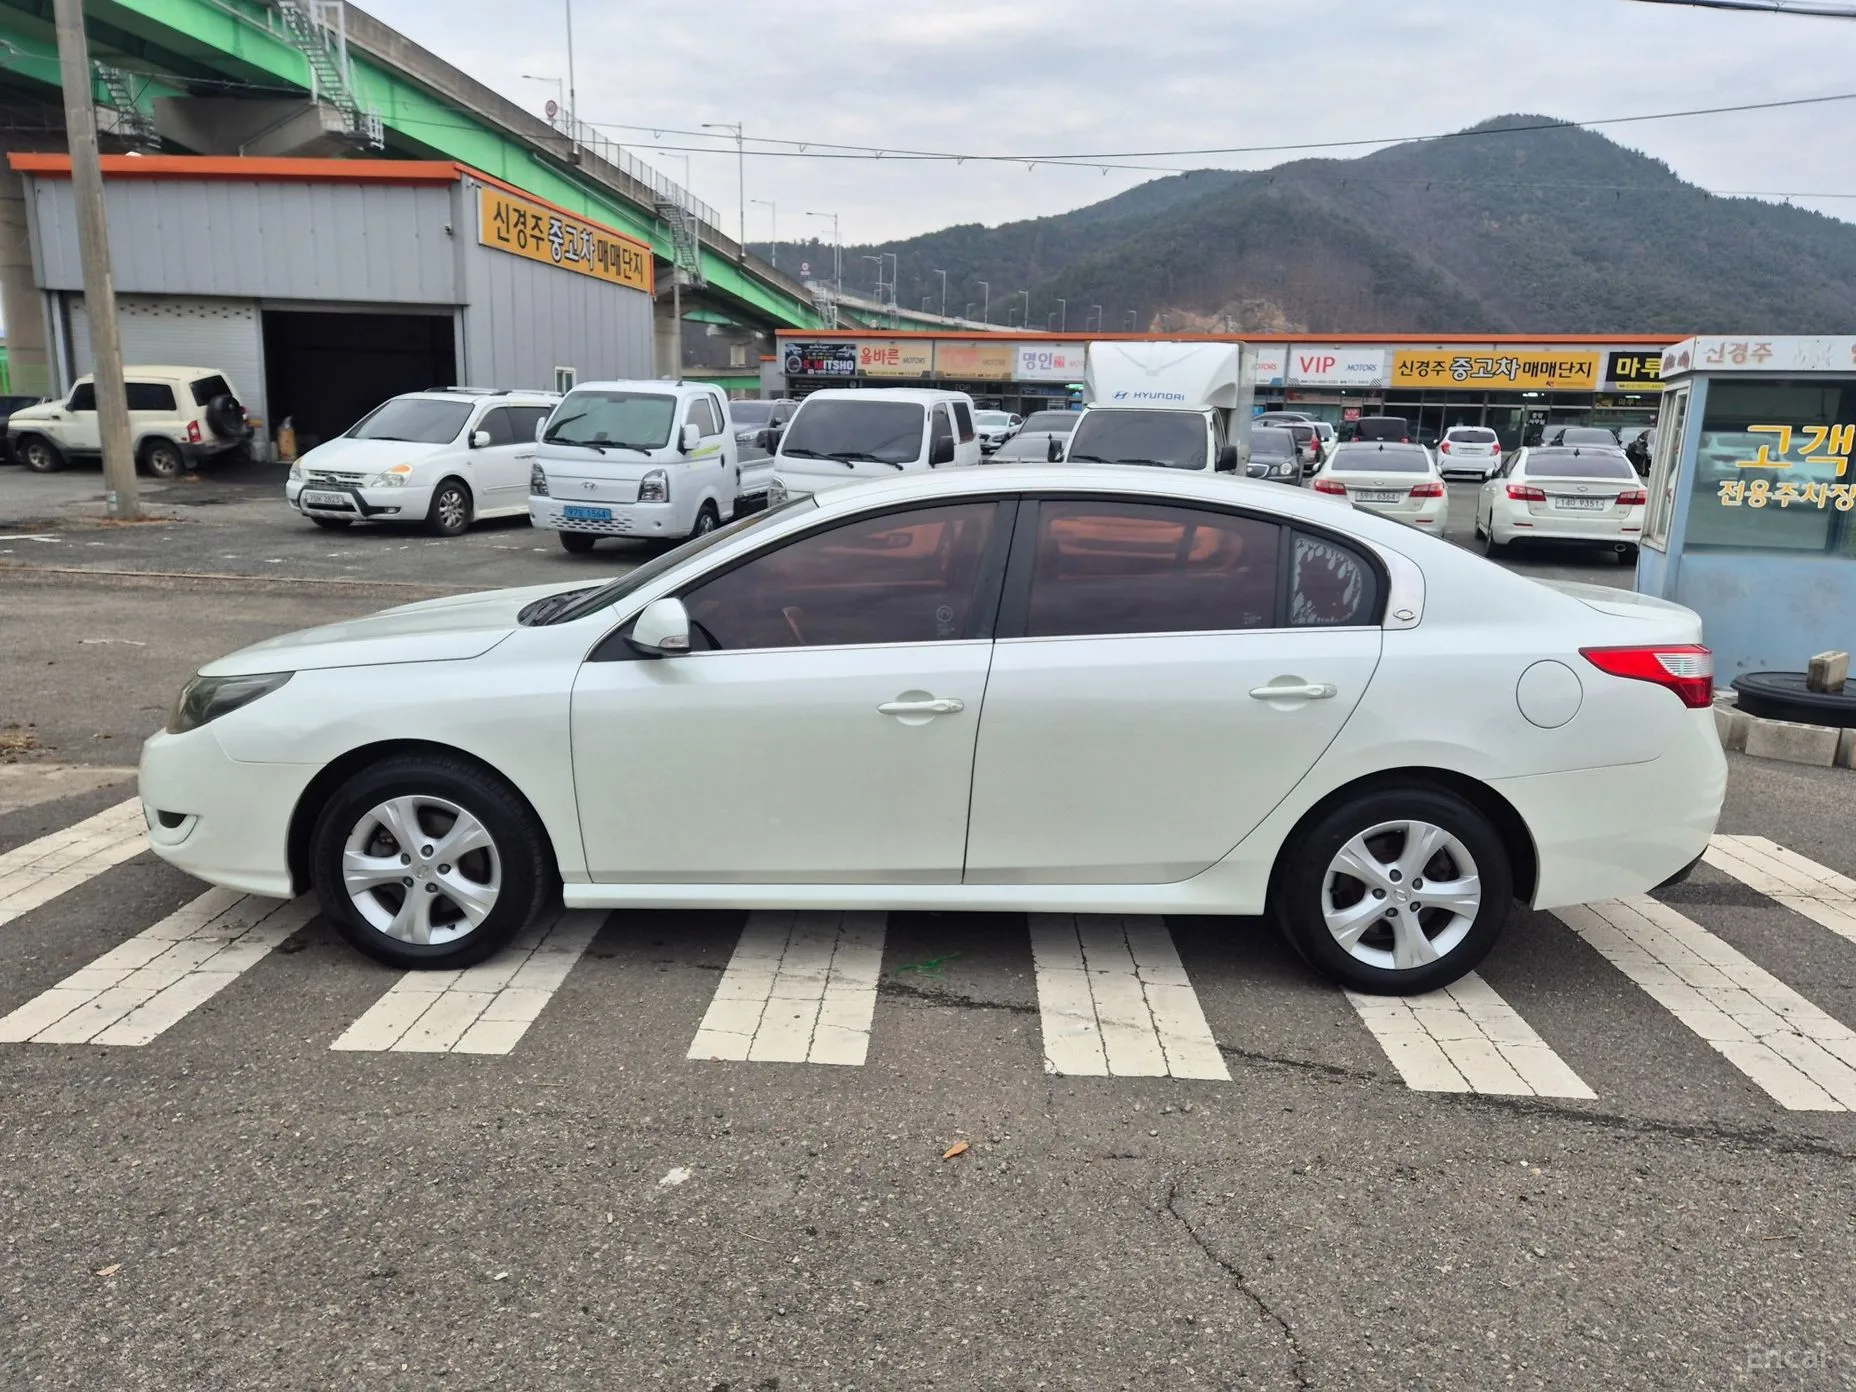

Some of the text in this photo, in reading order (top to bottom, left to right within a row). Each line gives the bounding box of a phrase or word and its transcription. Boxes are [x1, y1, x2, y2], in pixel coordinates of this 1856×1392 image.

[860, 346, 900, 366] 올바른
[1022, 352, 1053, 370] 명인
[1704, 341, 1774, 365] 신경주
[1300, 356, 1378, 373] VIP MOTORS
[1134, 391, 1185, 401] HYUNDAI
[1735, 423, 1856, 477] 고객
[1717, 479, 1856, 512] 전용주차장
